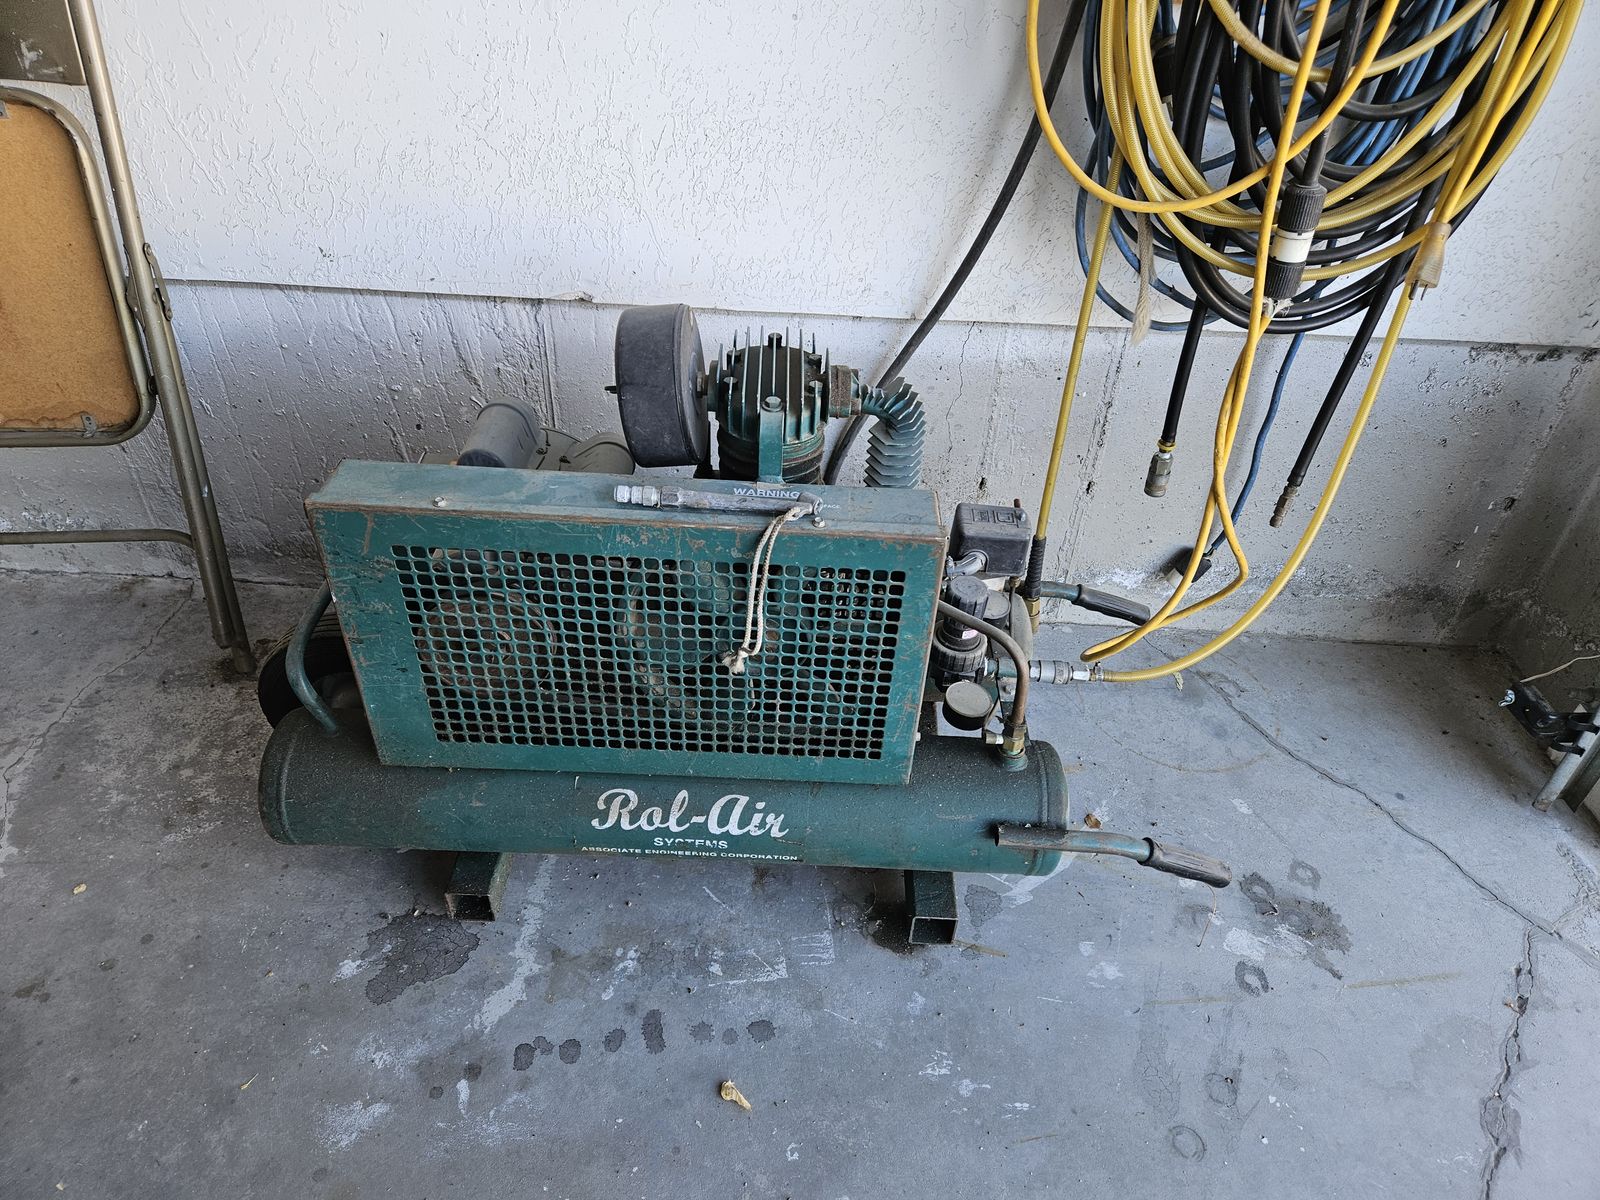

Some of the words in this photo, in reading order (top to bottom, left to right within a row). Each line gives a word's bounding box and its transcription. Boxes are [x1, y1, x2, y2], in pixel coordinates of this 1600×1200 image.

[733, 488, 800, 499] WARNING
[591, 788, 789, 838] Rol-Air
[581, 846, 641, 854] ASSOCIATE
[645, 849, 717, 857] ENGINEERING
[720, 852, 798, 861] CORPORATION
